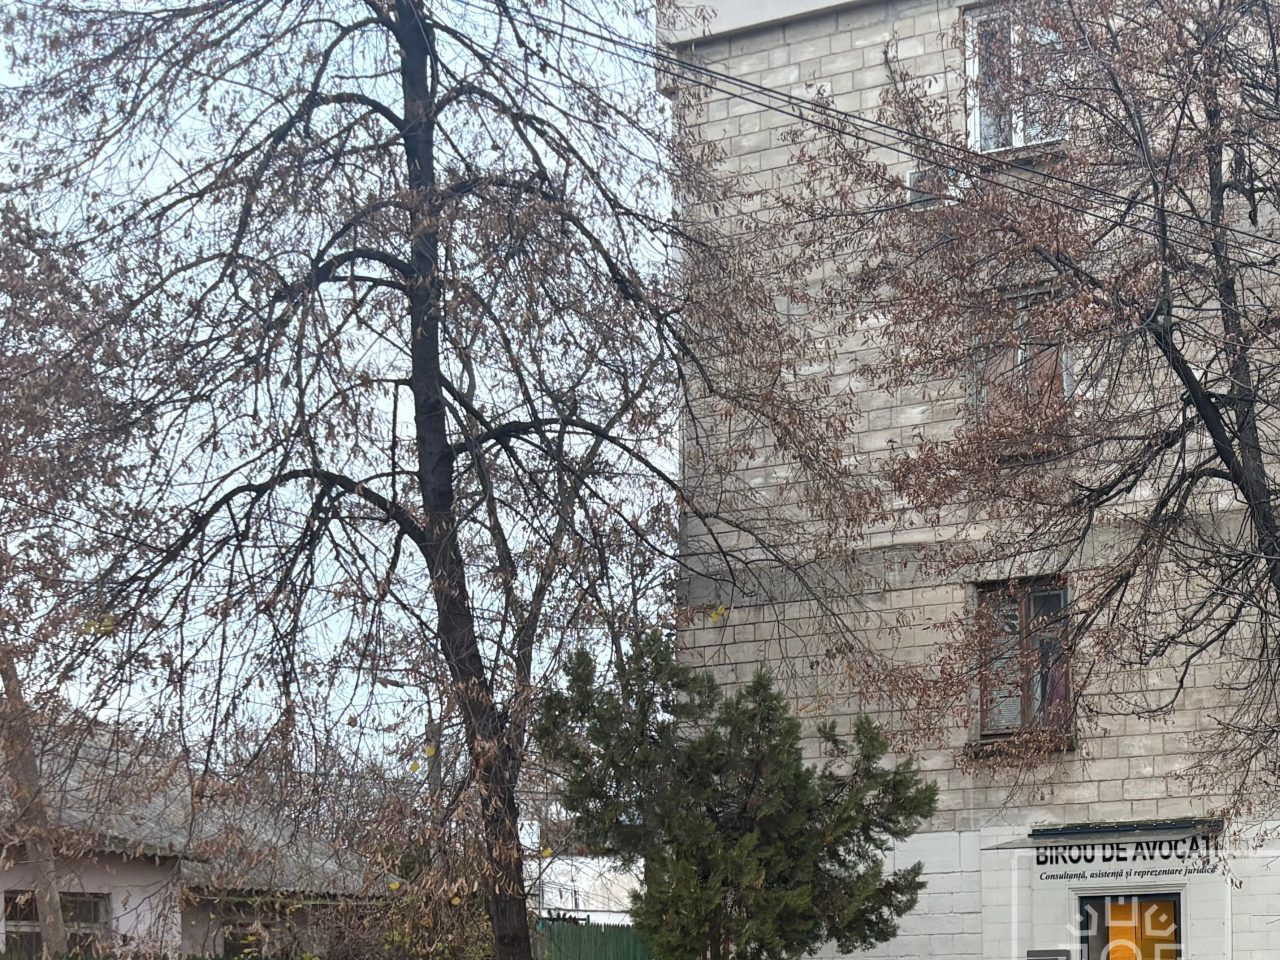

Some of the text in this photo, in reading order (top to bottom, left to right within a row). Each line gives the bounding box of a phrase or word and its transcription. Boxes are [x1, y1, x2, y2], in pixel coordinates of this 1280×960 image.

[1036, 844, 1096, 866] BIROU
[1102, 842, 1128, 863] DE
[1134, 867, 1183, 879] reprezentare
